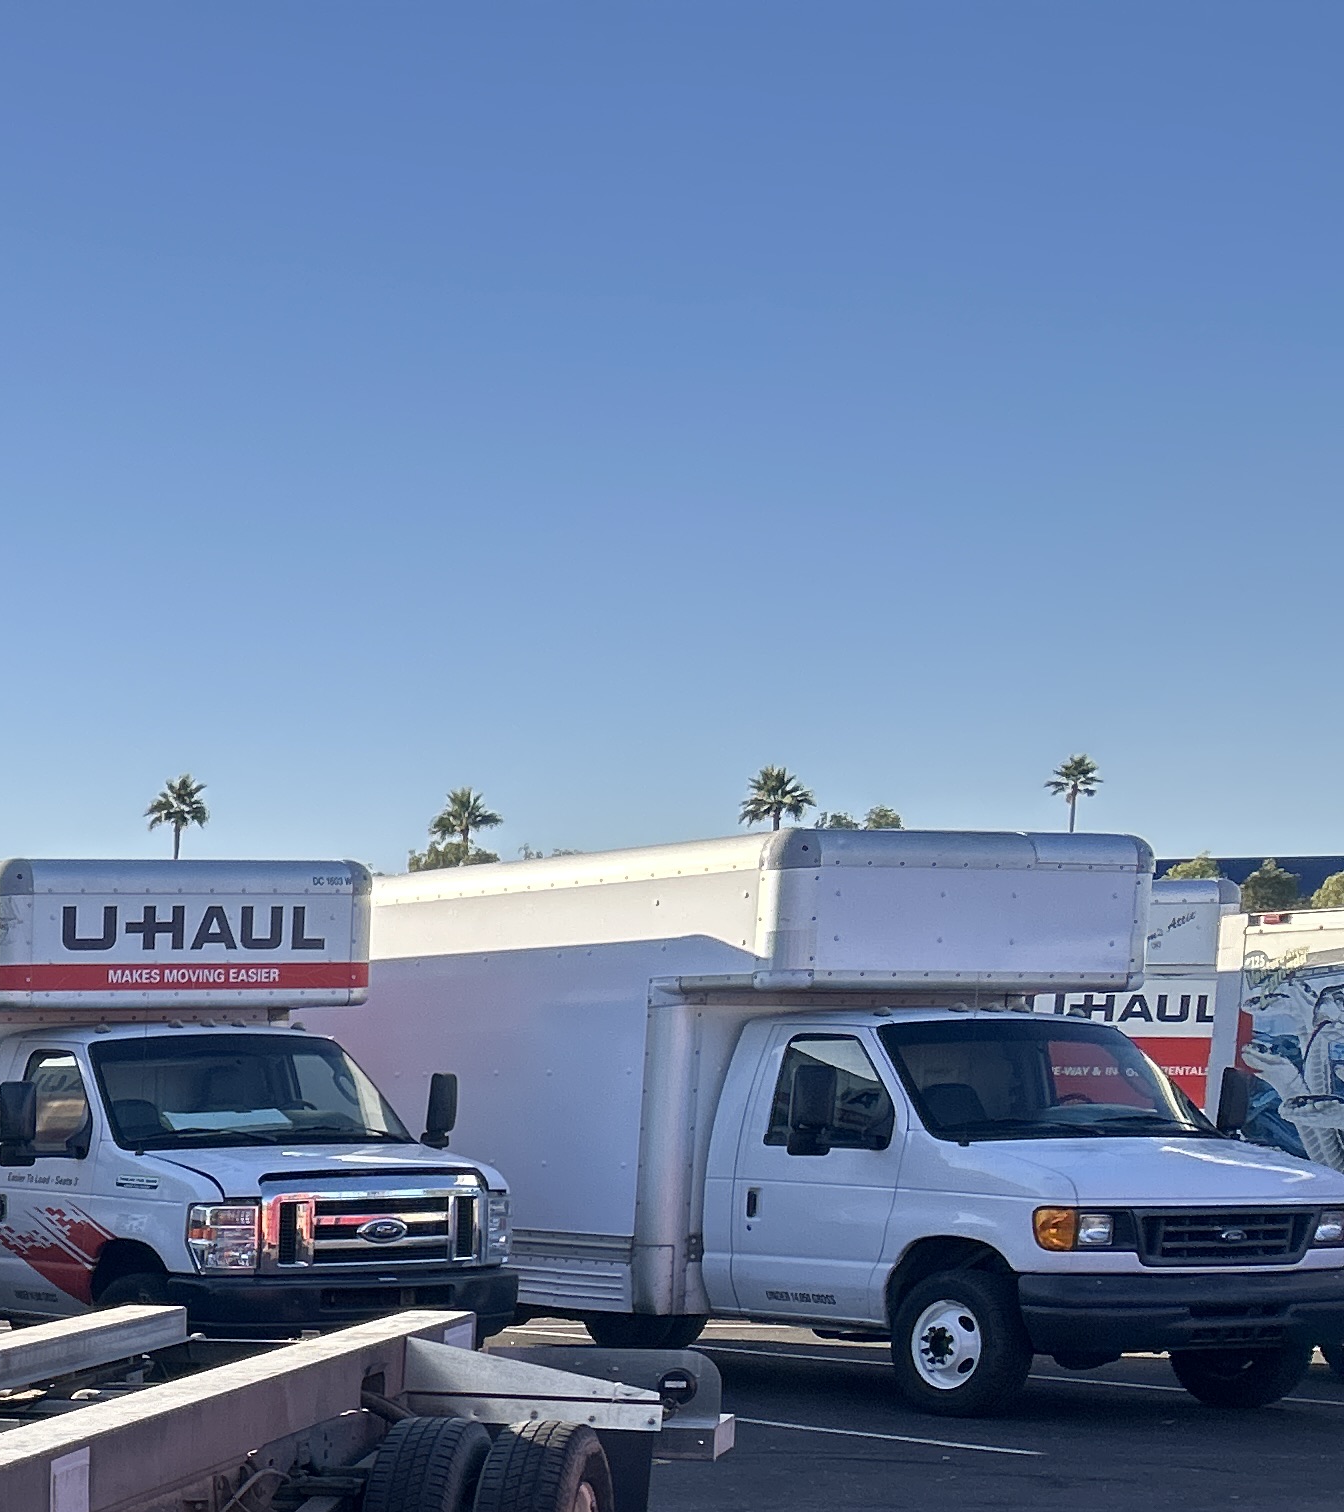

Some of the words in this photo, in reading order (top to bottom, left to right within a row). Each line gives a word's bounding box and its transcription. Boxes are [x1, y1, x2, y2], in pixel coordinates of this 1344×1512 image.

[62, 905, 325, 951] U-HAUL
[108, 969, 161, 984] MAKES
[163, 969, 225, 984] MOVING
[229, 968, 279, 983] EASIER
